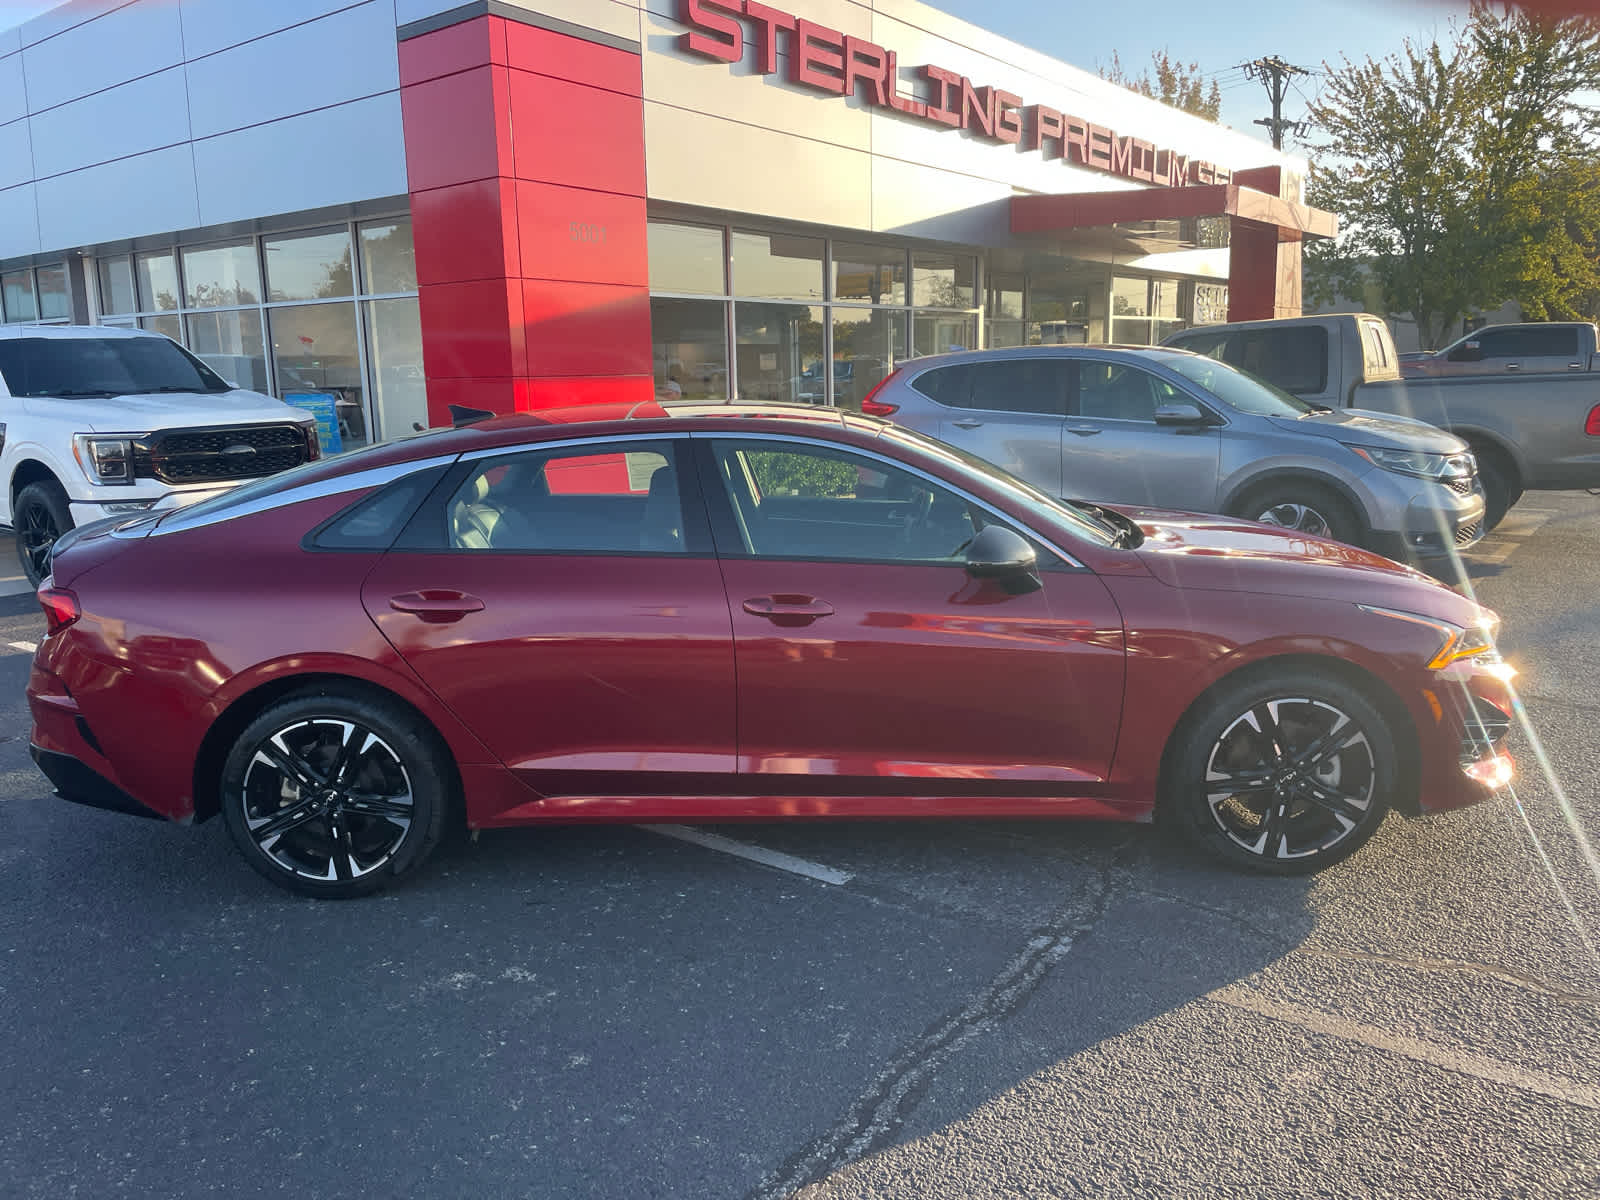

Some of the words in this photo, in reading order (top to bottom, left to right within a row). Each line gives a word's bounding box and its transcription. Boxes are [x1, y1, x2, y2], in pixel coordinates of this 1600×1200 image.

[680, 0, 1023, 144] STERLING
[1033, 104, 1189, 188] PREMIUM
[568, 221, 608, 246] 5001
